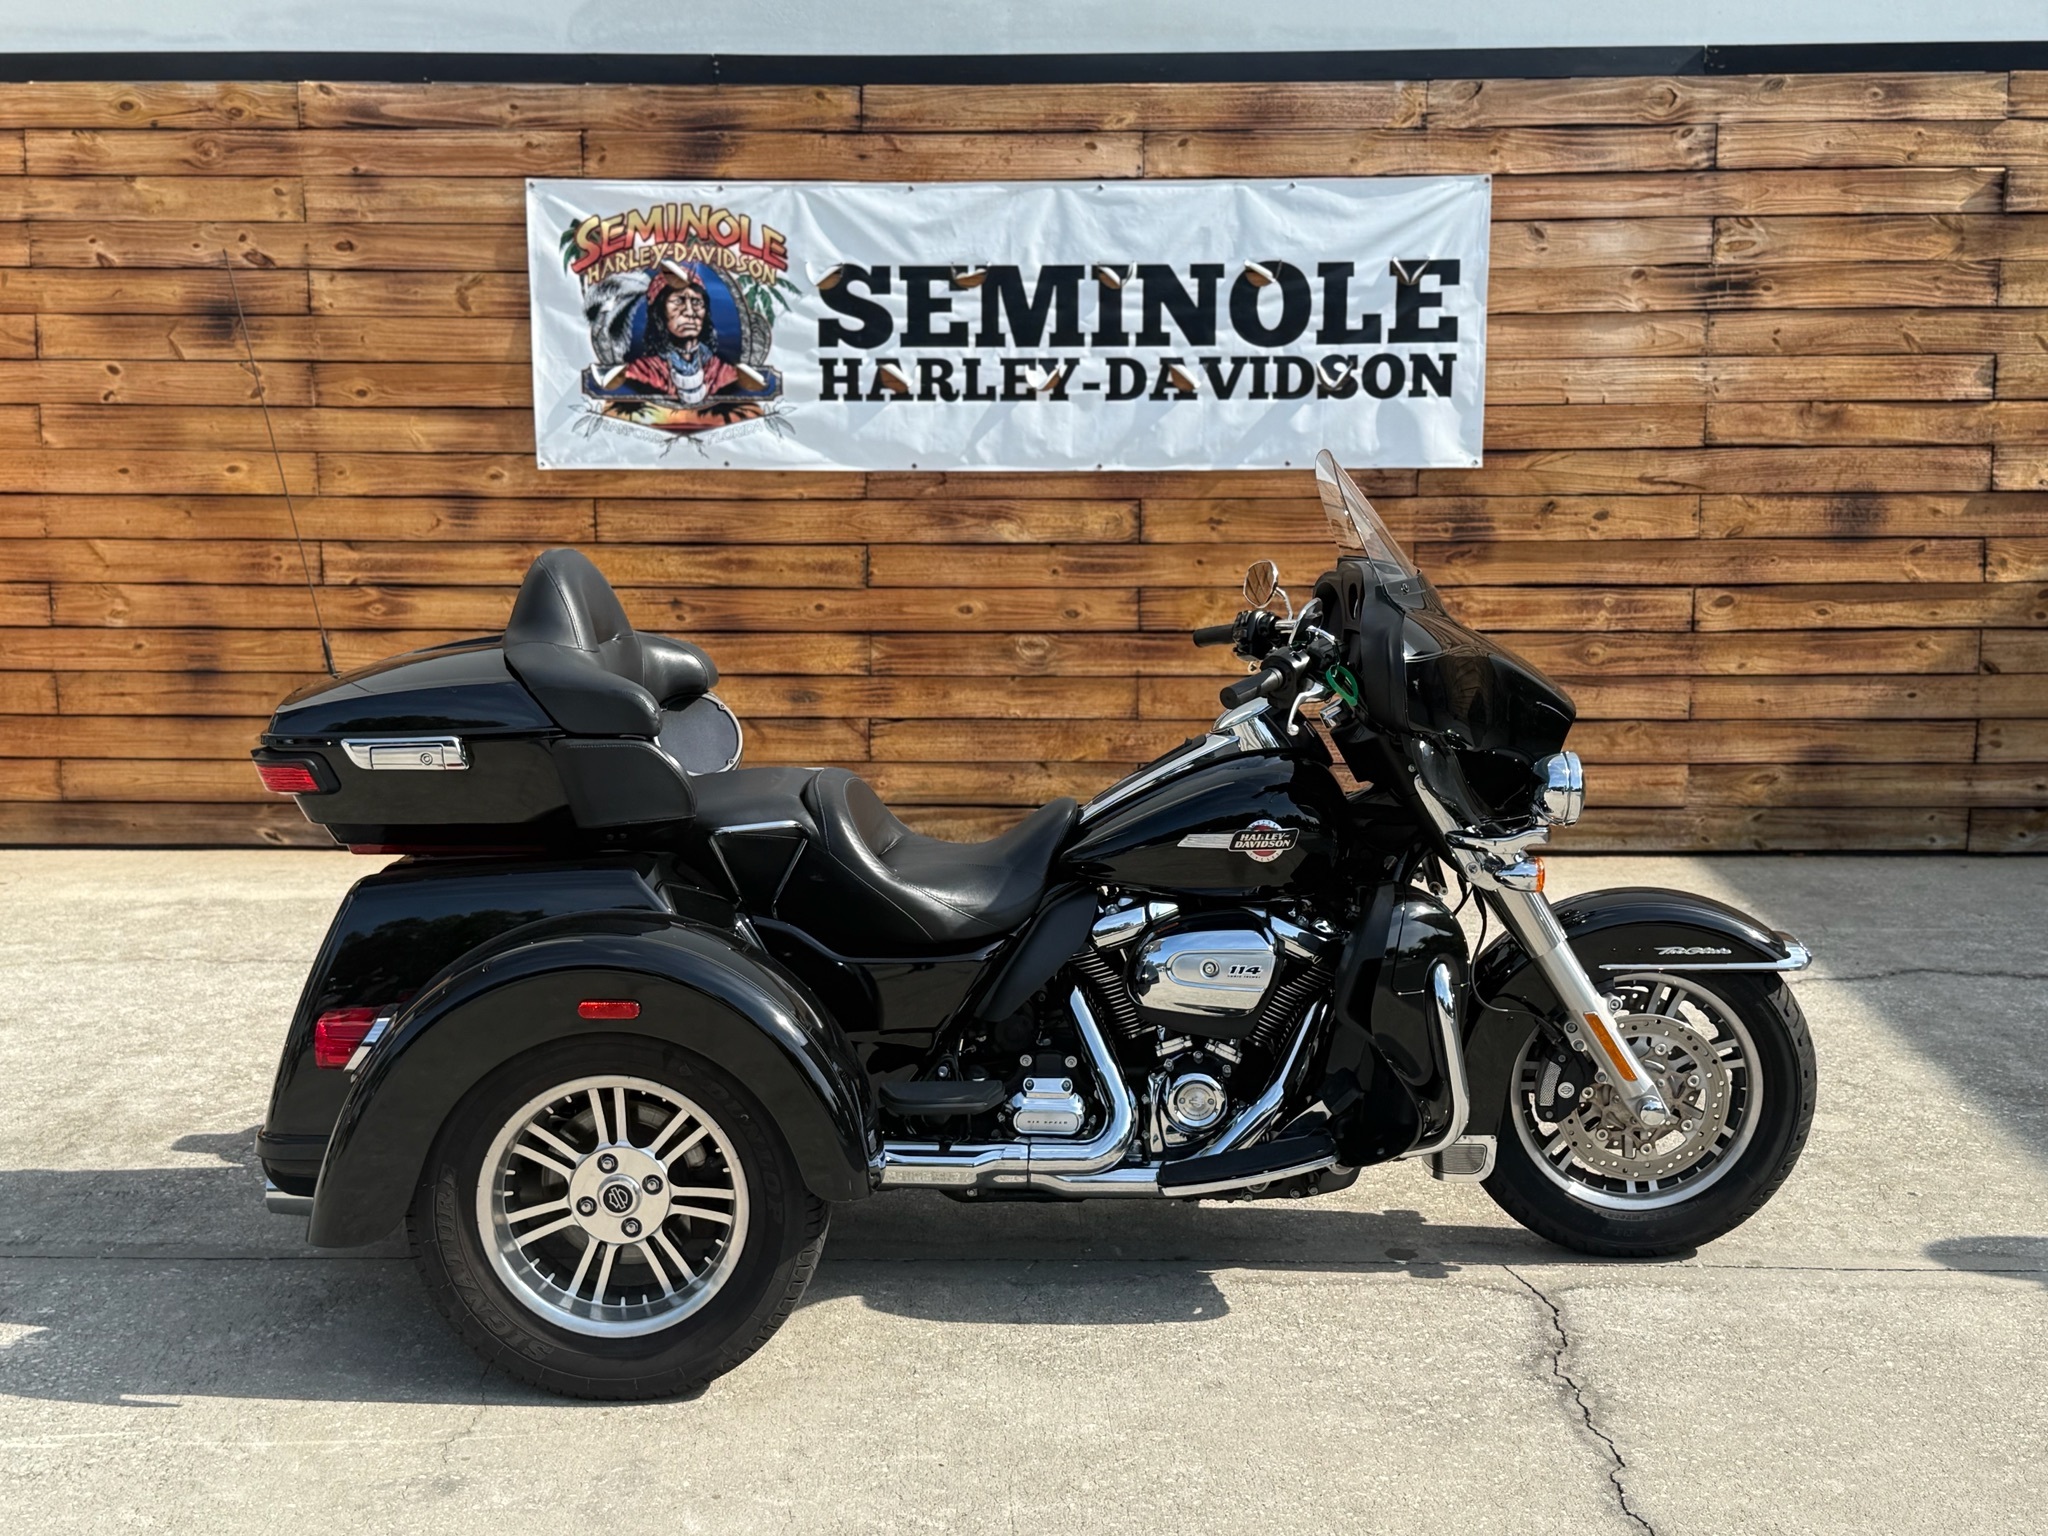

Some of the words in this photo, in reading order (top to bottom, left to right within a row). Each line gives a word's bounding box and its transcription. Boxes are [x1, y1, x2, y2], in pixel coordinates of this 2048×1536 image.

[571, 203, 788, 273] SEMINOLE
[586, 243, 776, 285] HARLEY-DAVIDSON
[818, 259, 1461, 349] SEMINOLE
[1235, 840, 1291, 848] DAVIDSON
[1228, 965, 1262, 975] 114
